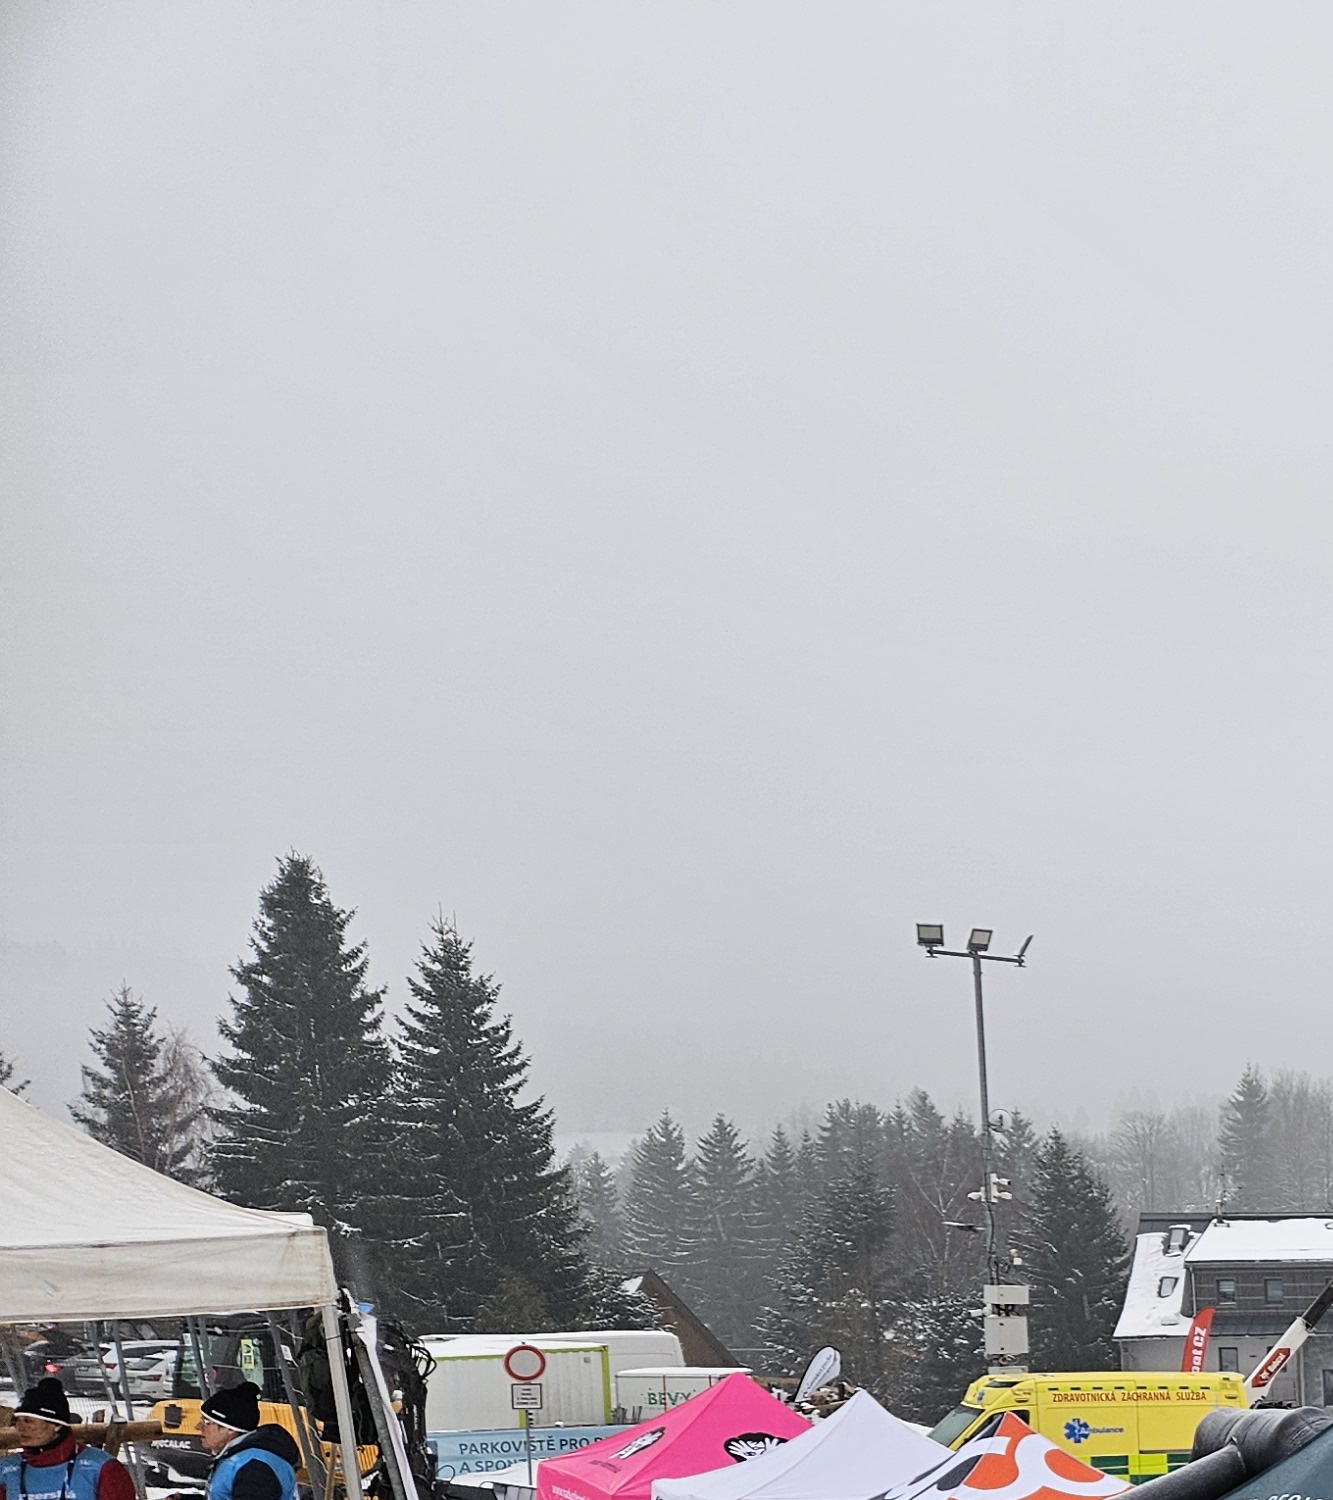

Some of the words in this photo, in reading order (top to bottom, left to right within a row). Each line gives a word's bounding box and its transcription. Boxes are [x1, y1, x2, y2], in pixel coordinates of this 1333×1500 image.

[1176, 1389, 1207, 1401] SLUŽBA
[459, 1434, 556, 1455] PARKOVIŠTĚ
[560, 1437, 590, 1451] PRO
[459, 1461, 471, 1474] A
